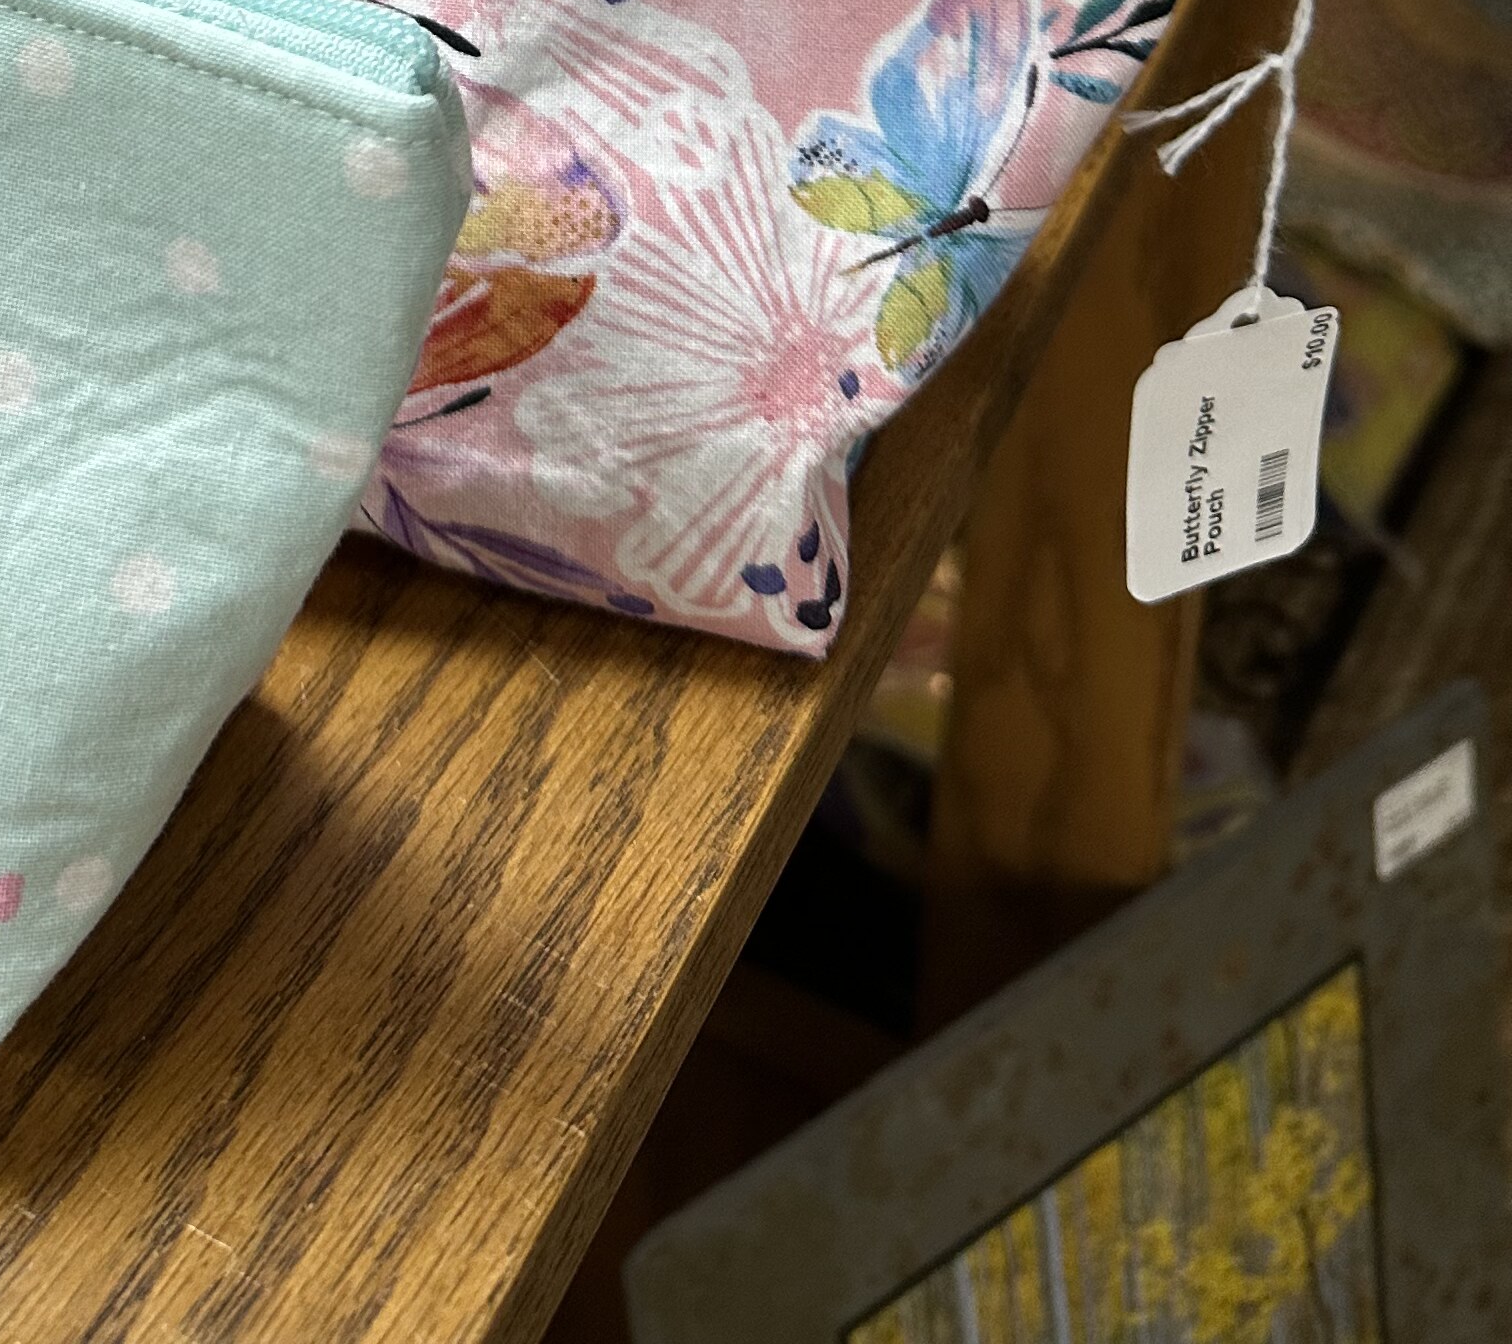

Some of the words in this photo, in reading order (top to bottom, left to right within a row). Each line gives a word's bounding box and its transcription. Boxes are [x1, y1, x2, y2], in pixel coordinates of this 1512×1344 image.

[1302, 313, 1332, 370] $10.00
[1189, 395, 1216, 456] Zipper
[1181, 464, 1208, 563] Butterfly
[1203, 487, 1224, 556] Pouch
